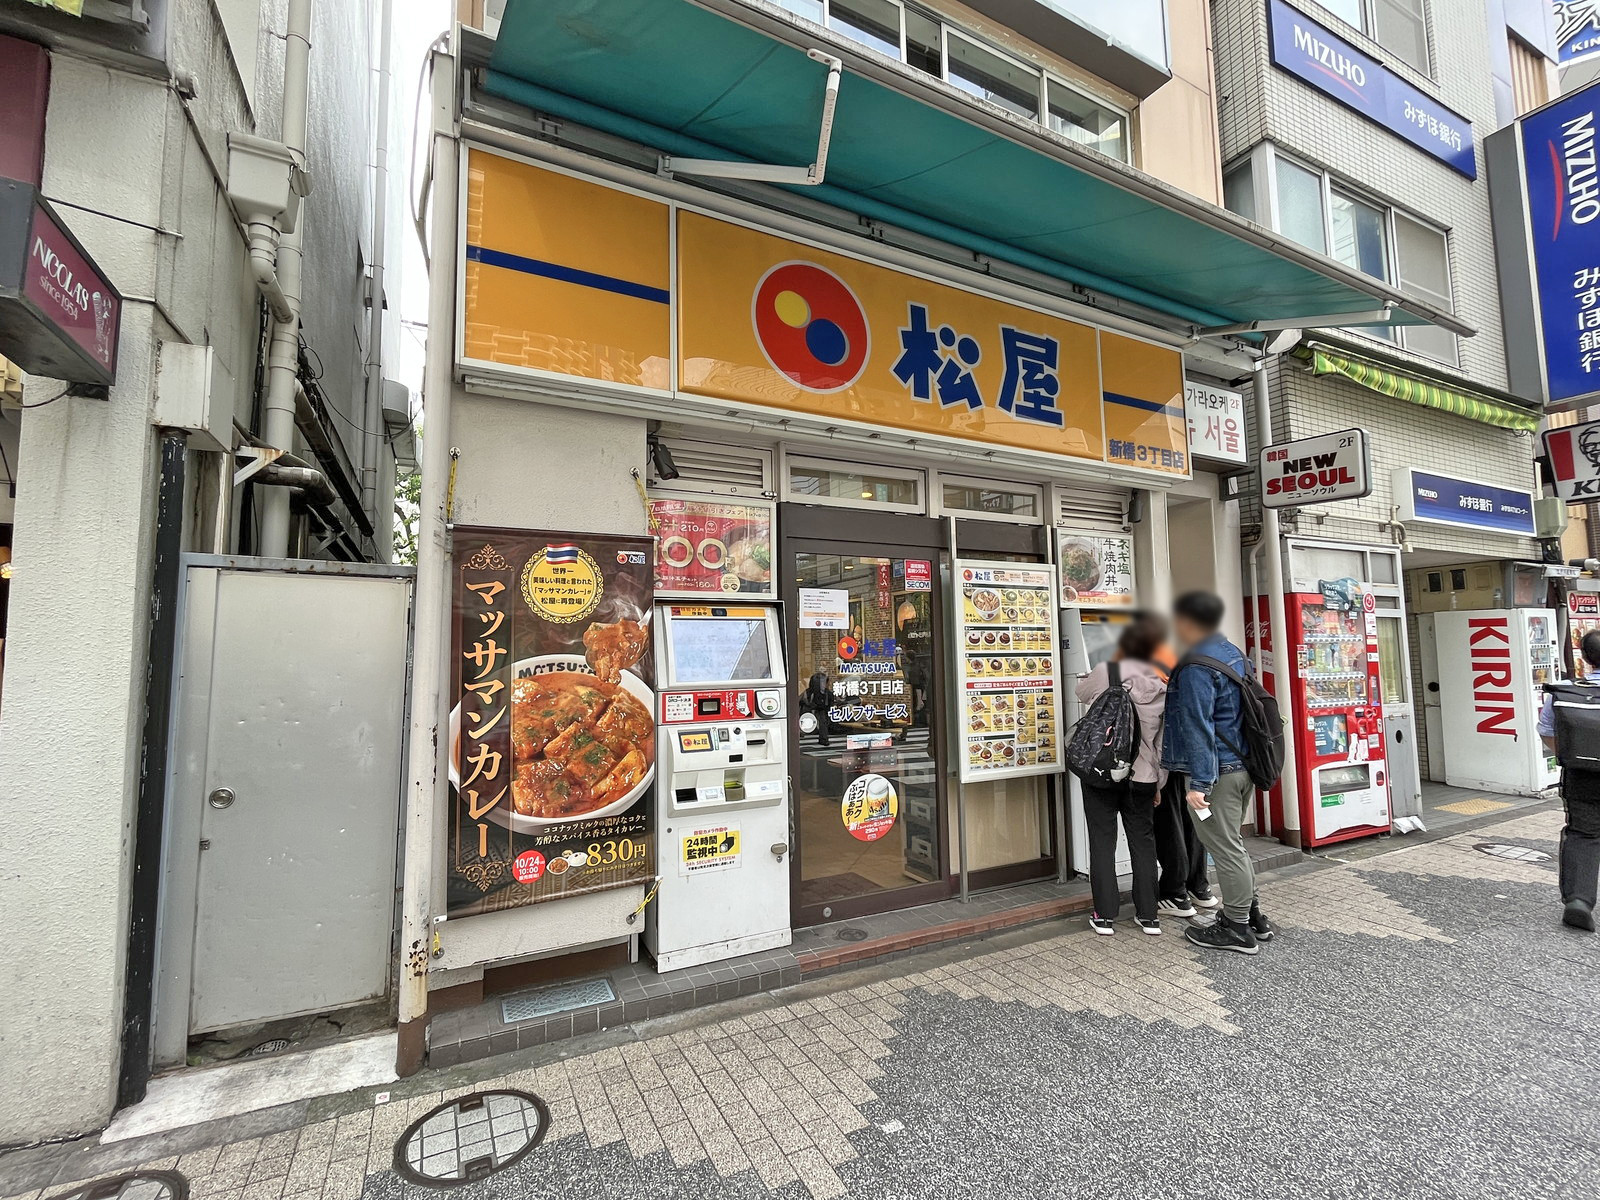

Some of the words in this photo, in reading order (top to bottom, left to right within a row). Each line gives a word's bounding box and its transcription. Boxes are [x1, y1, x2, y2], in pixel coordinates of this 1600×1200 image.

[1293, 24, 1366, 87] MIZUHO
[1403, 100, 1462, 152] みずほ銀行
[1561, 111, 1600, 225] MIZUHO
[39, 275, 61, 302] since
[61, 294, 78, 320] 1954
[890, 301, 1065, 428] 松屋
[1187, 387, 1229, 414] 가라오케
[1230, 398, 1240, 409] 2F
[1205, 415, 1240, 454] 서울
[1339, 436, 1354, 448] 2F
[1108, 438, 1185, 470] 新橋3丁目店
[1266, 449, 1288, 462] 韓国
[1283, 451, 1337, 475] NEW
[1266, 466, 1355, 495] SEOUL
[1287, 486, 1337, 499] ニューソウル
[1417, 487, 1438, 500] MIZUHO
[1459, 495, 1493, 512] みずほ銀行
[1103, 538, 1118, 587] 牛焼肉丼
[1116, 539, 1131, 576] ネギ塩
[552, 567, 574, 575] 世界一
[975, 571, 991, 581] 松屋
[533, 576, 592, 585] 美味しい料理と言われた
[906, 580, 930, 589] SECOM
[534, 587, 591, 596] 「マッサマンカレー」が
[861, 637, 897, 658] 松屋
[839, 662, 897, 674] MATSUYA
[1468, 617, 1517, 740] KIRIN
[832, 680, 904, 697] 新橋3丁目店
[461, 581, 507, 858] マッサマンカレー
[828, 704, 908, 723] セルフサービス
[869, 802, 887, 813] Asahi
[543, 814, 646, 834] ココナッツミルクの濃厚なコクと
[686, 835, 718, 848] 24時間
[586, 838, 646, 867] 830円
[686, 846, 718, 860] 監視中
[696, 857, 718, 865] SECURITY
[719, 855, 736, 864] SYSTEM
[515, 855, 540, 869] 10/24
[518, 866, 539, 876] 10:00
